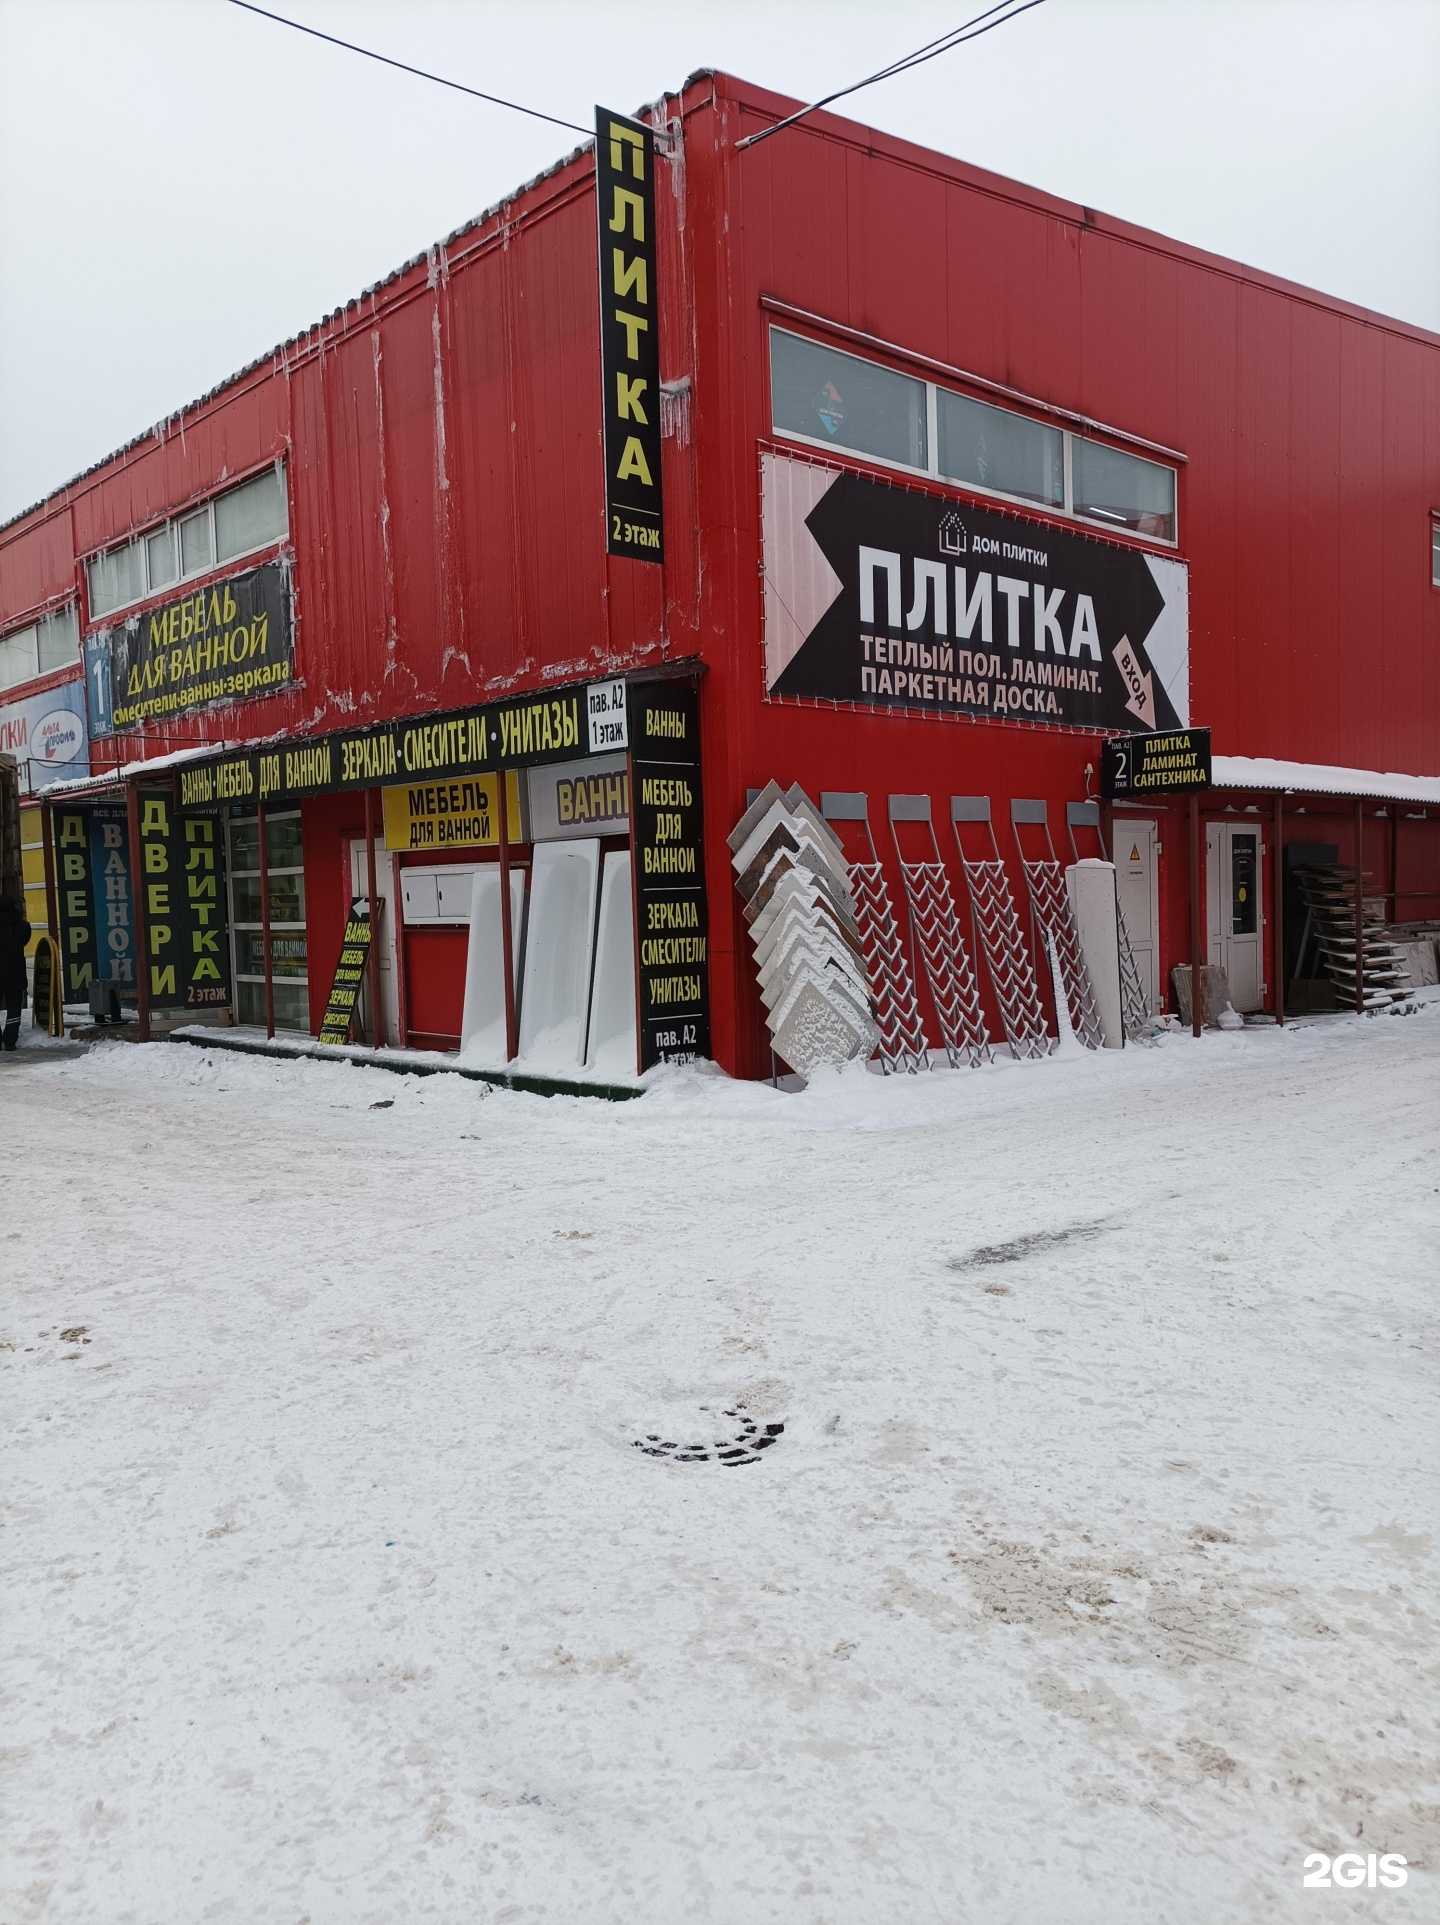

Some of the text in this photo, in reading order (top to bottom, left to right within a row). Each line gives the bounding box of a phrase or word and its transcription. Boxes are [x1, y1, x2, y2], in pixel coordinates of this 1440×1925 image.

[609, 121, 654, 486] ПЛИТКА
[613, 515, 660, 549] 2 этаж
[972, 536, 1048, 567] ДОМ ПЛИТКИ
[150, 586, 237, 651] МЕБЕЛЬ
[859, 545, 1103, 662] ПЛИТКА
[127, 611, 268, 697] ДЛЯ ВАННОЙ
[860, 634, 1103, 694] ТЕПЛЫЙ ПОЛ. ЛАМИНАТ.
[93, 660, 104, 715] 1
[861, 666, 1064, 715] ПАРКЕТНАЯ ДОСКА.
[1120, 653, 1148, 711] ВХОД
[590, 684, 623, 715] пав. А2
[593, 721, 624, 744] 1 этаж
[646, 708, 686, 739] ВАННЫ
[181, 697, 579, 805] ВАННЫ МЕБЕЛЬ ДЛЯ ВАННОЙ ЗЕРКАЛА СМЕСИТЕЛИ УНИТАЗЫ
[1145, 735, 1191, 754] ПЛИТКА
[1115, 753, 1127, 779] 2
[1134, 768, 1207, 787] САНТЕХНИКА
[1142, 753, 1197, 771] ЛАМИНАТ
[409, 783, 489, 817] МЕБЕЛЬ
[642, 779, 693, 807] МЕБЕЛЬ
[410, 811, 490, 844] ДЛЯ ВАННОЙ
[656, 813, 682, 845] ДЛЯ
[60, 816, 94, 991] ДВЕРИ
[103, 823, 134, 982] ВАННОЙ
[141, 800, 176, 996] ДВЕРИ
[185, 819, 221, 981] ПЛИТКА
[647, 902, 698, 930] ЗЕРКАЛА
[641, 937, 706, 966] СМЕСИТЕЛИ
[187, 985, 226, 1002] 2 этаж
[650, 975, 701, 1005] УНИТАЗЫ
[656, 1025, 696, 1047] пав. А2
